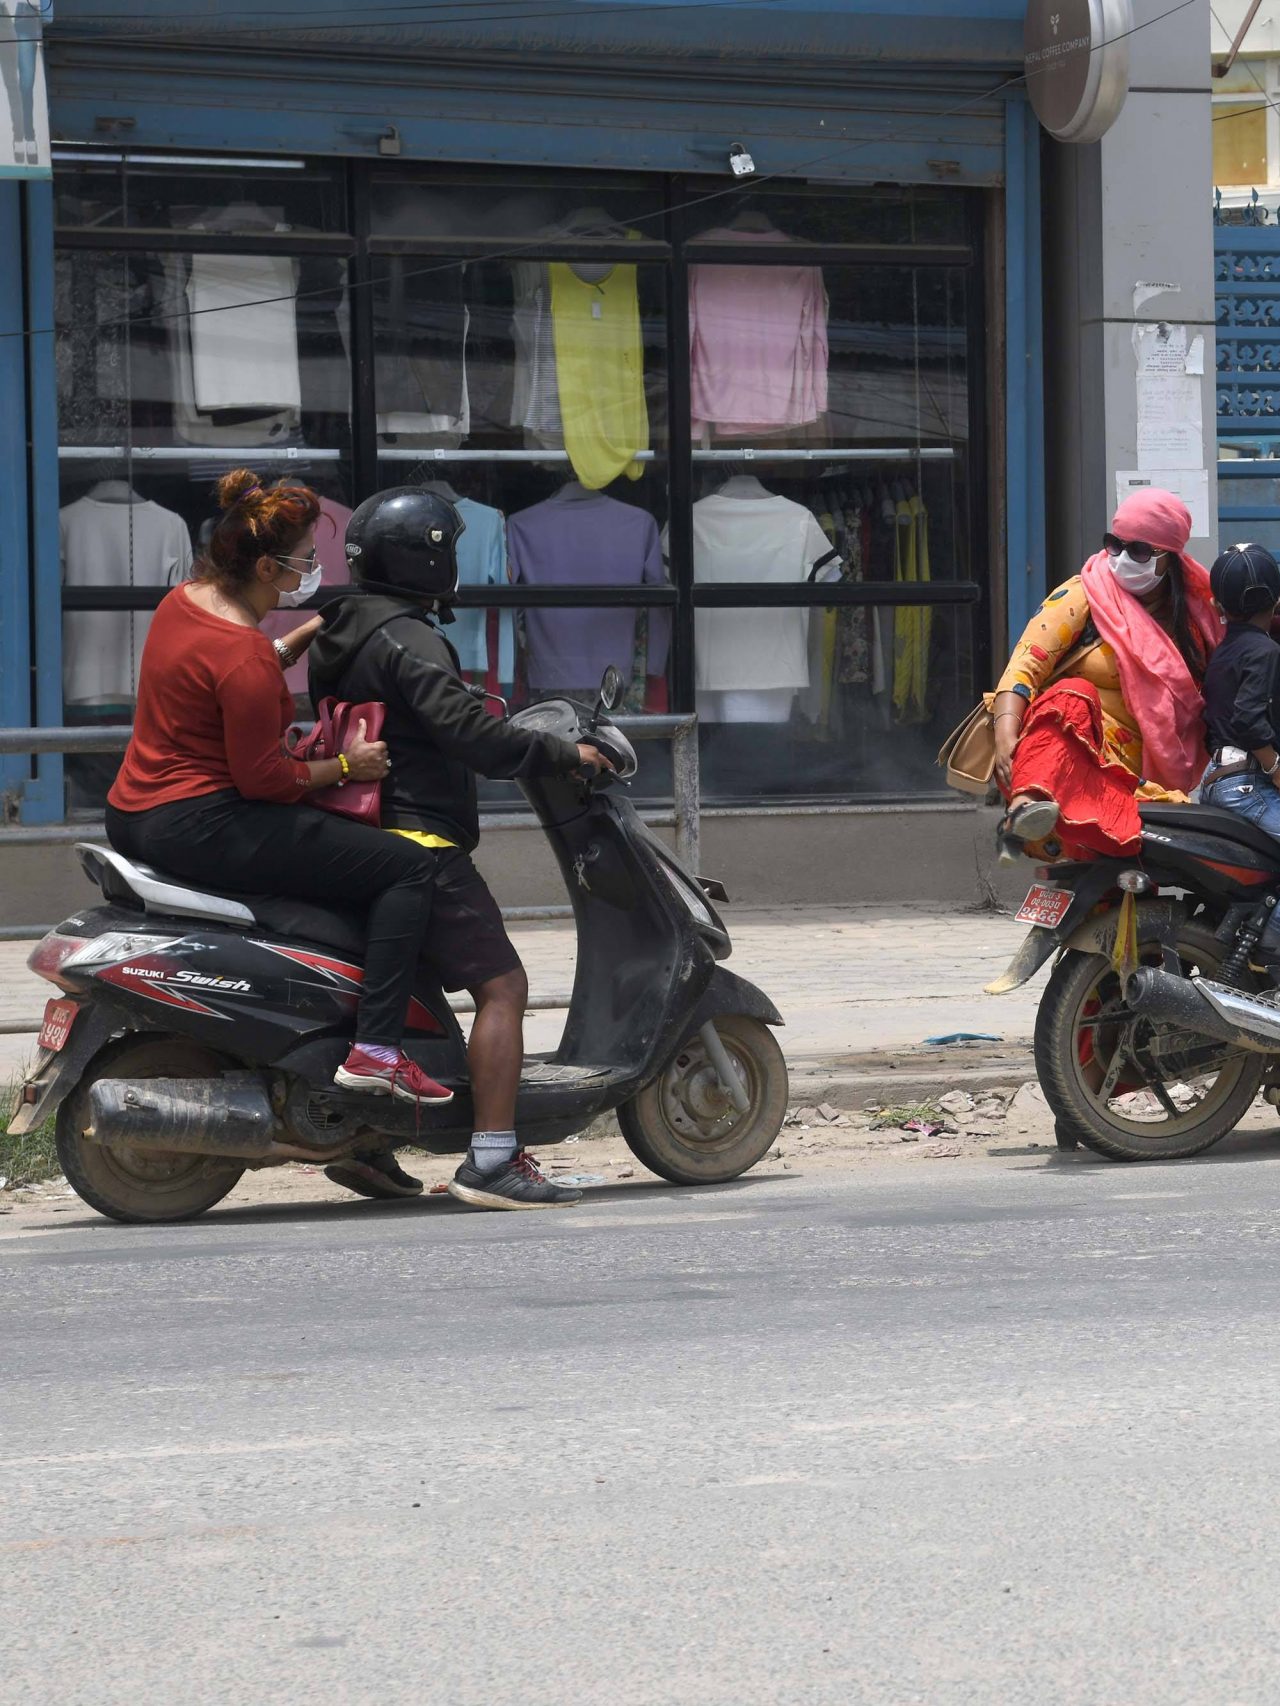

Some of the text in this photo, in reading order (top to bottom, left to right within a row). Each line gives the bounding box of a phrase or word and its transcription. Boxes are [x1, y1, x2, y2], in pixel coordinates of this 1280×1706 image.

[1041, 44, 1062, 59] COFFEE
[1062, 36, 1090, 52] COMPANY
[122, 966, 251, 992] SUZUKI Swish
